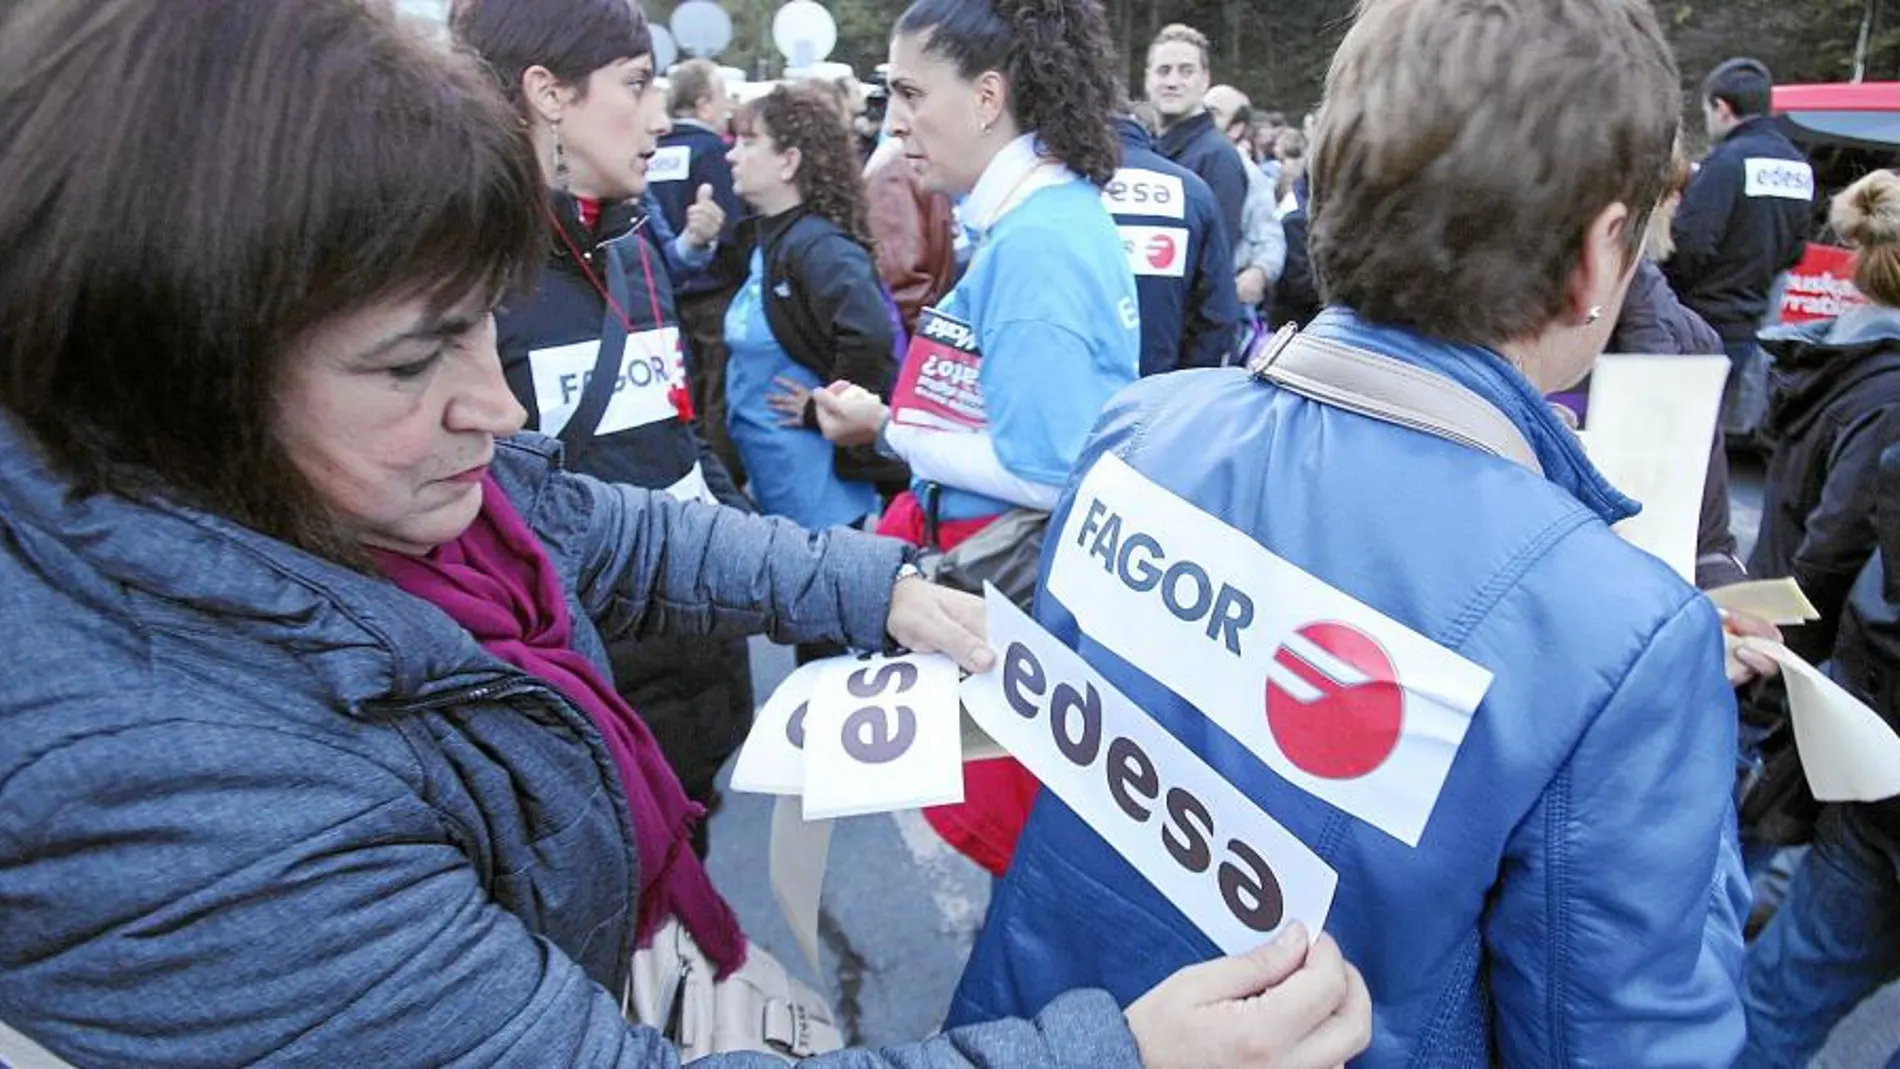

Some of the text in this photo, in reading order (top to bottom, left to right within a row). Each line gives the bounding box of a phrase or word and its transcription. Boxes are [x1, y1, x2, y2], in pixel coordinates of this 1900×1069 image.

[559, 355, 668, 405] FOR
[1077, 498, 1255, 657] FAGOR
[840, 652, 919, 765] es
[1002, 640, 1285, 933] edesa
